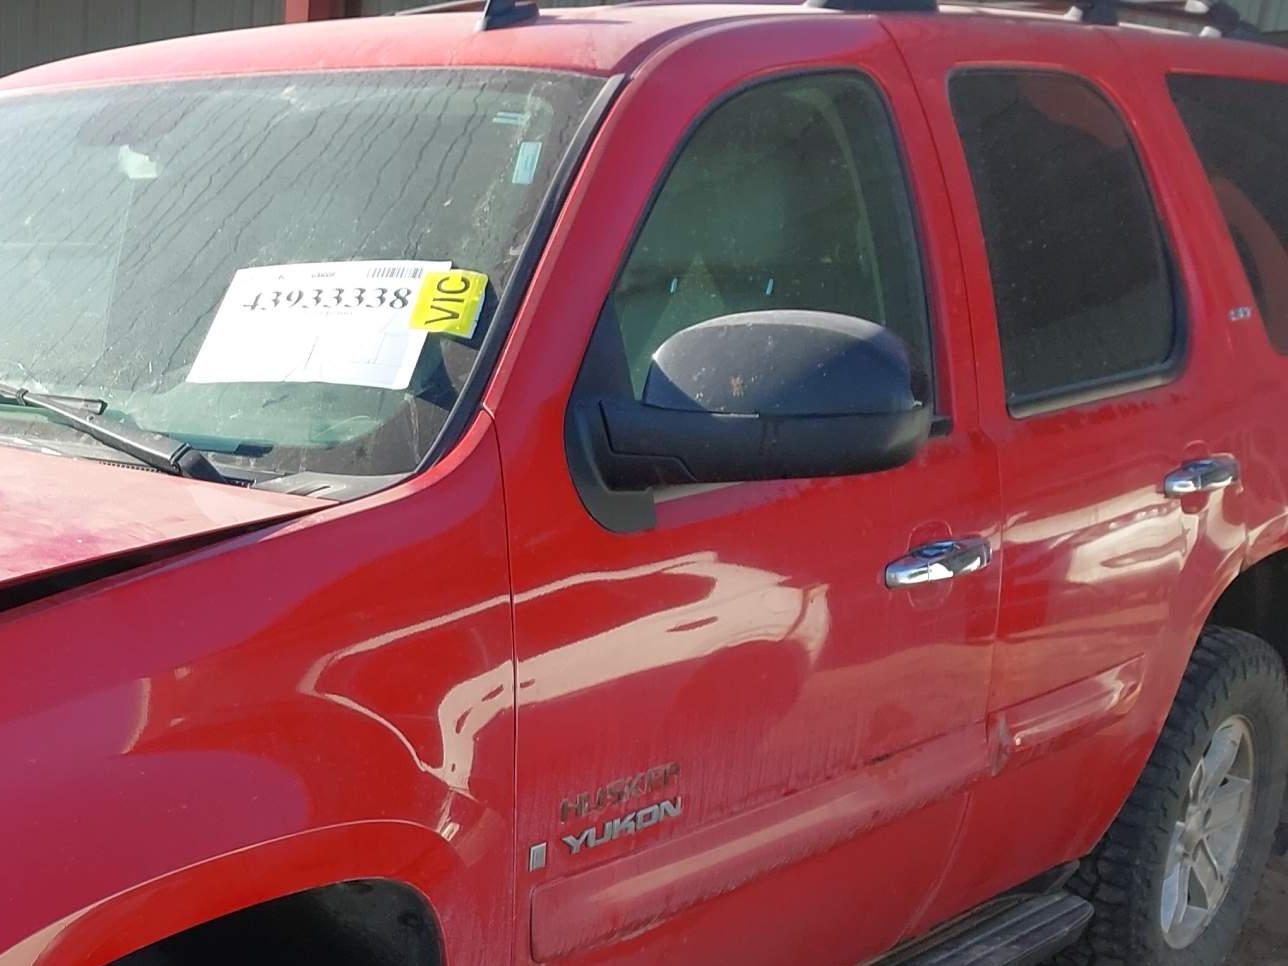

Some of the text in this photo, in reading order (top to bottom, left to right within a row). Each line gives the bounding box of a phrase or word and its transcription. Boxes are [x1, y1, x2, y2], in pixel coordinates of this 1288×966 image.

[242, 286, 413, 312] 43933338
[424, 276, 471, 326] VIC
[561, 795, 683, 856] YUKON
